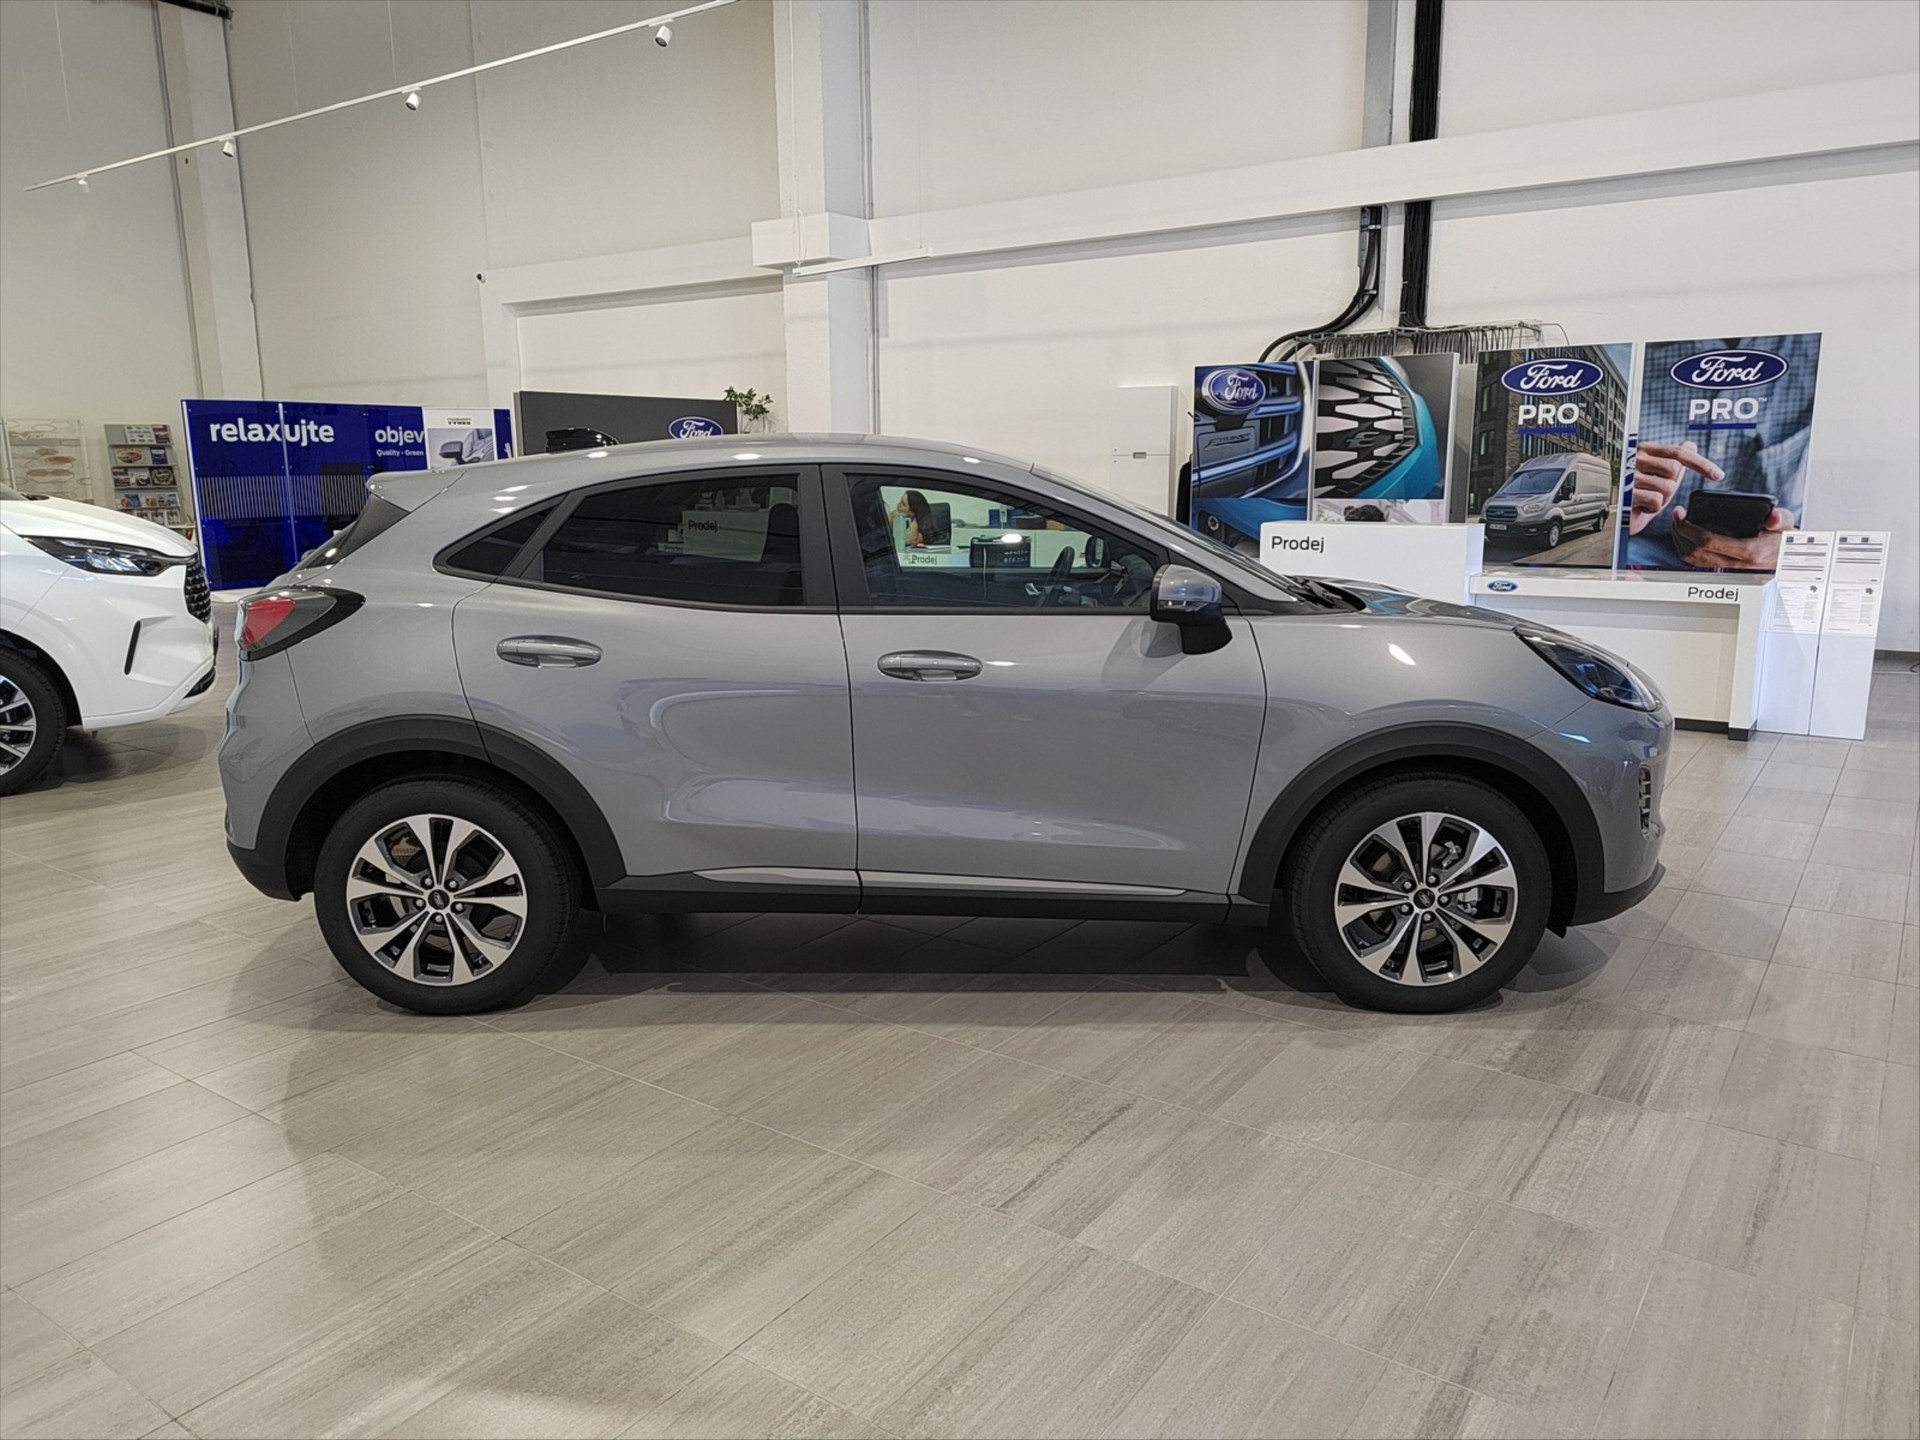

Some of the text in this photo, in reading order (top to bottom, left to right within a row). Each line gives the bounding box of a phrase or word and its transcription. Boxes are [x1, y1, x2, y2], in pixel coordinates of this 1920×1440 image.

[1520, 364, 1584, 390] Ford
[1692, 355, 1765, 383] Ford
[1225, 374, 1258, 401] Ford
[1517, 402, 1580, 426] PRO
[209, 417, 335, 447] relaxujte
[374, 425, 425, 446] objev
[680, 419, 714, 439] Ford
[376, 449, 401, 457] Quality
[687, 520, 718, 533] Prodej
[1271, 535, 1325, 554] Prodej
[910, 554, 938, 565] Prodej
[1687, 586, 1740, 602] Prodej
